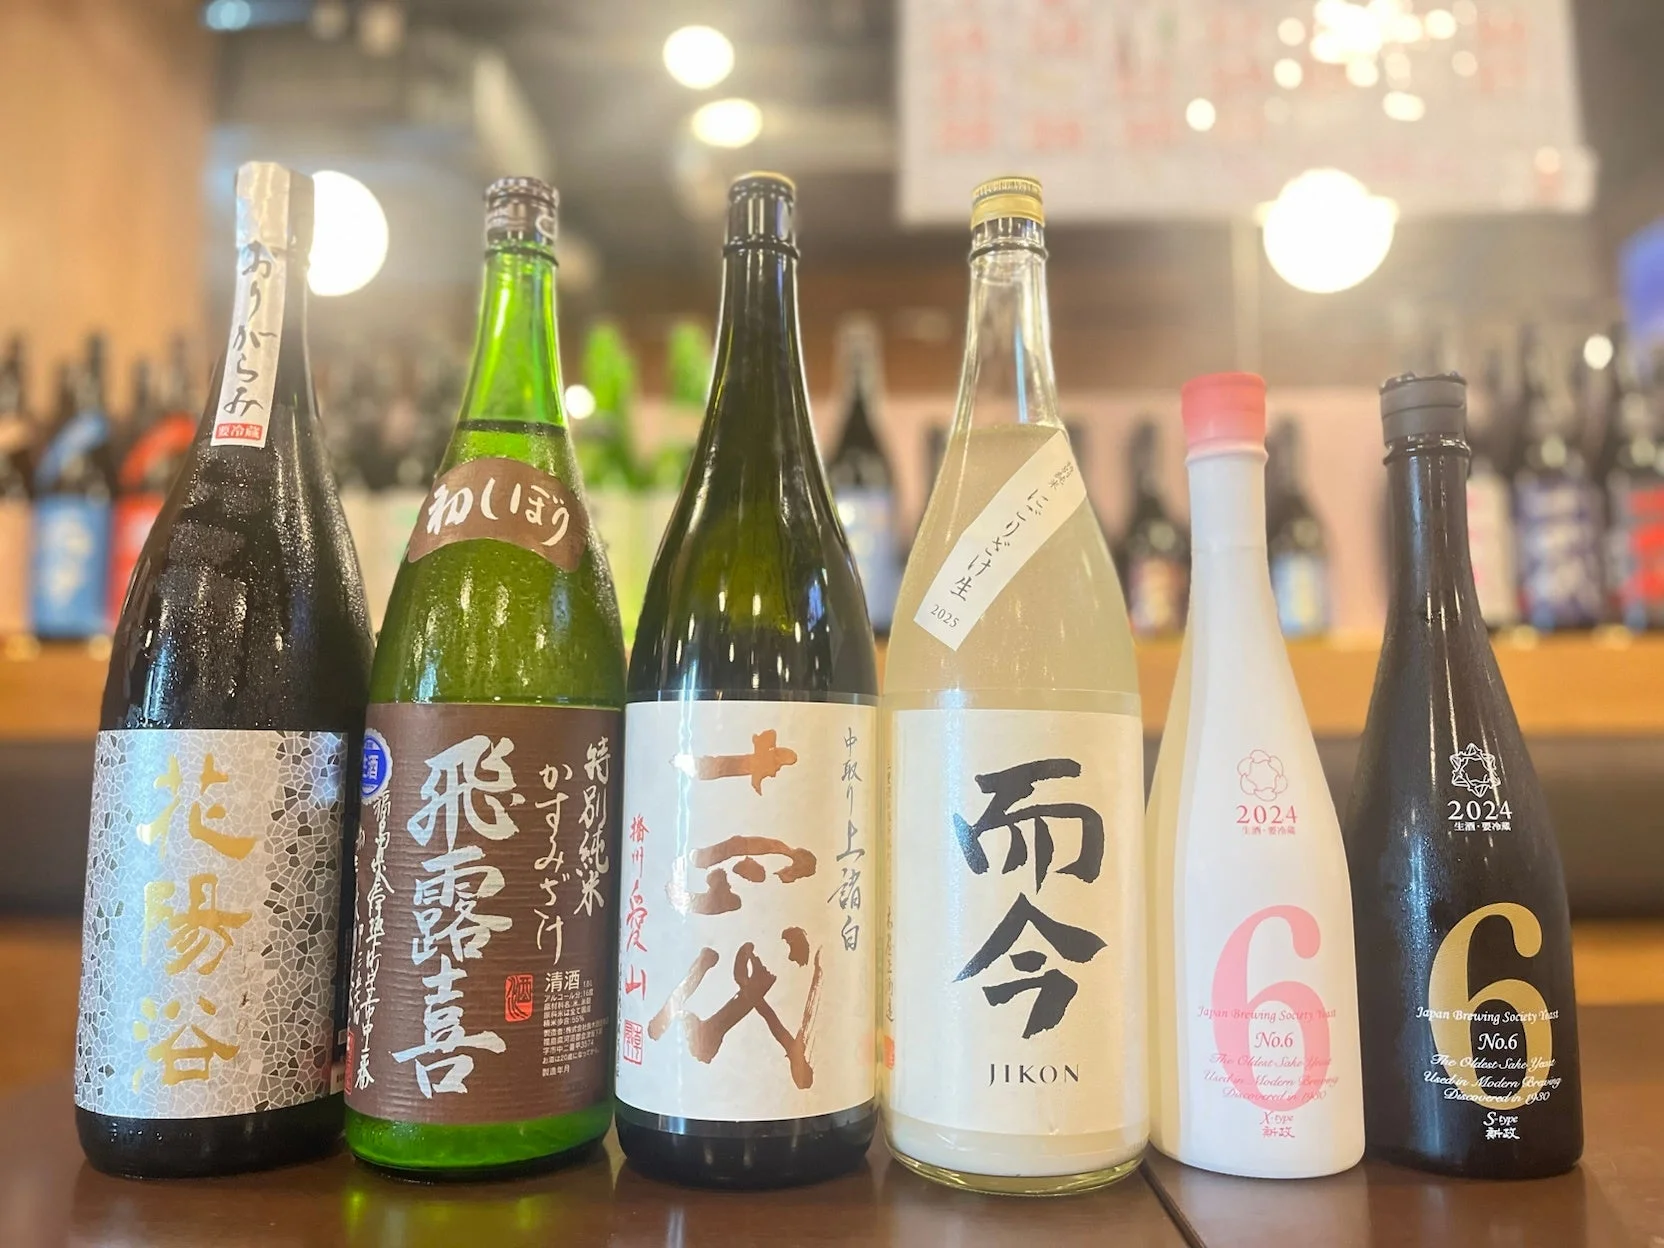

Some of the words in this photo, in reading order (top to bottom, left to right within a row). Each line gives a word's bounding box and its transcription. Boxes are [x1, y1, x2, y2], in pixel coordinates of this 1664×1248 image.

[224, 240, 278, 418] おりがらみ
[426, 477, 570, 547] 初しぼり
[950, 488, 1049, 601] にごりざけ生
[930, 604, 961, 628] 2025
[1235, 805, 1298, 824] 2024
[1447, 800, 1513, 820] 2024
[573, 736, 611, 916] 特別純米
[648, 729, 823, 1090] 十四代
[952, 758, 1108, 1039] 而今
[392, 735, 525, 1098] 飛露喜
[545, 969, 580, 992] 清酒
[1197, 1006, 1228, 1019] Japan
[1231, 1009, 1276, 1023] Brewing
[1279, 1010, 1313, 1023] Society
[1211, 905, 1330, 1111] 6
[1416, 1006, 1449, 1022] Japan
[1452, 1010, 1500, 1025] Brewing
[1502, 1012, 1538, 1024] Society
[1429, 902, 1552, 1110] 6
[1254, 1032, 1294, 1048] No.6
[1477, 1033, 1518, 1050] No.6
[1209, 1053, 1234, 1065] The
[1430, 1054, 1456, 1067] The
[1459, 1057, 1498, 1069] Oldest
[1499, 1057, 1527, 1070] Sake
[988, 1064, 1080, 1087] JIKON
[1423, 1071, 1456, 1084] Used
[1456, 1077, 1468, 1086] in
[1472, 1075, 1520, 1088] Modern
[1522, 1076, 1561, 1089] Brewing
[1444, 1088, 1512, 1102] Discovered
[1512, 1094, 1523, 1102] in
[1483, 1111, 1518, 1126] S-type
